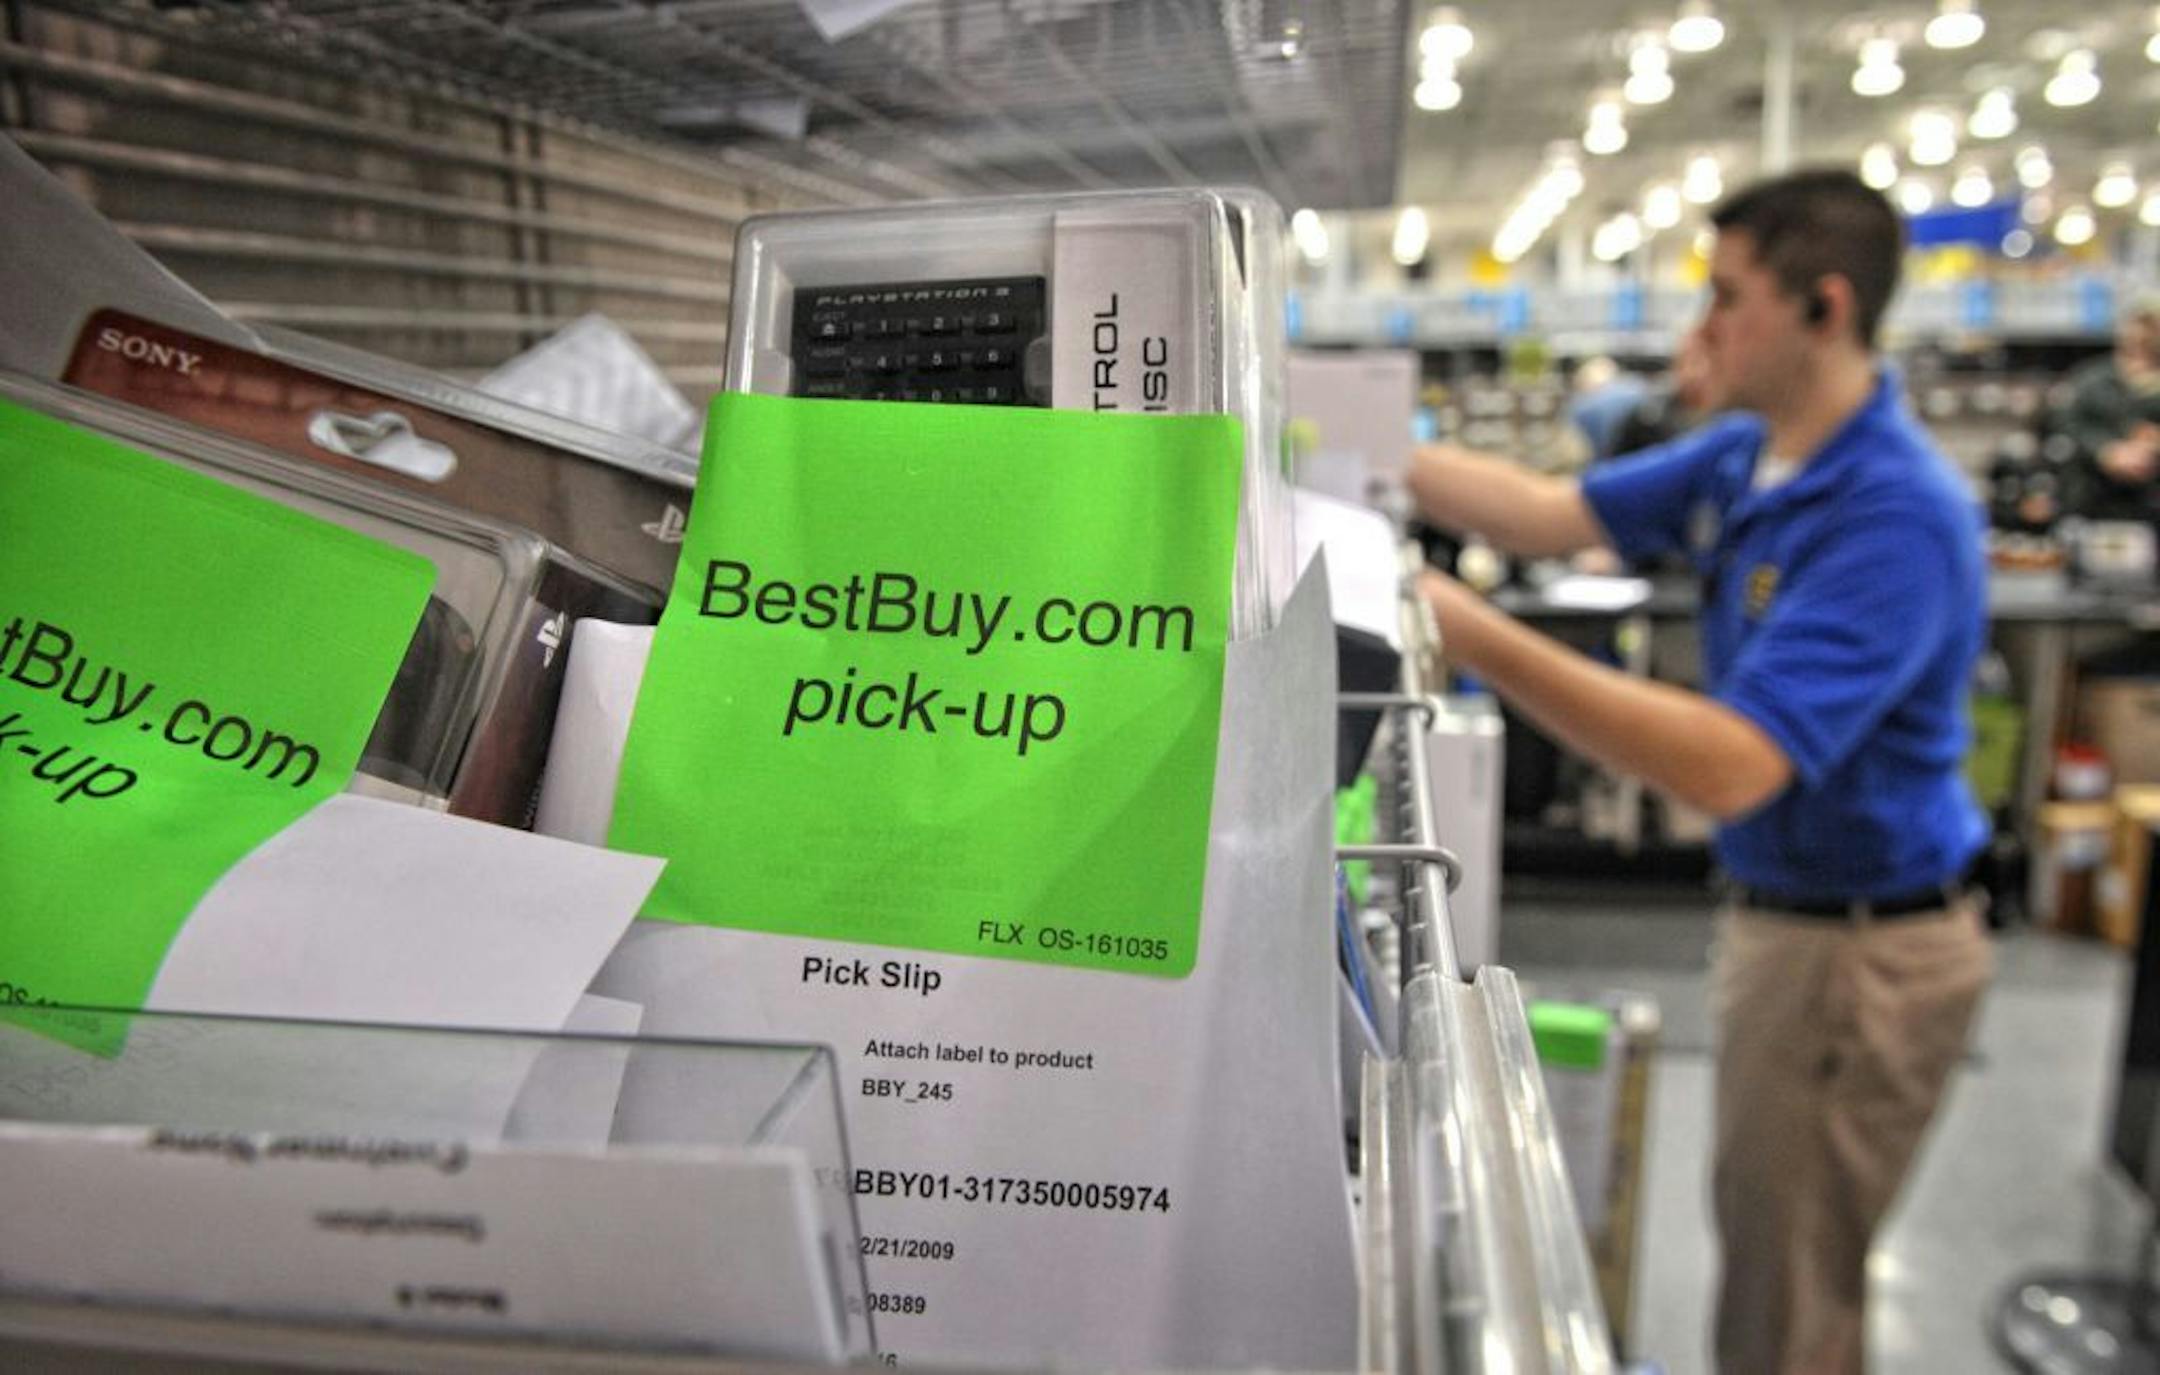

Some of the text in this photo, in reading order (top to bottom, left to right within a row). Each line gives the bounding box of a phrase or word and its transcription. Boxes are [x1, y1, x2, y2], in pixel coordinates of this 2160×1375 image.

[98, 327, 202, 375] SONY
[699, 559, 1194, 656] BestBuy.com
[0, 616, 320, 788] tBuy.com
[782, 667, 1066, 756] pick-up
[978, 920, 1169, 961] FLX OS-161035
[802, 956, 942, 996] Pick Slip
[864, 1039, 1095, 1073] Attach label to product
[861, 1078, 953, 1103] BBY_245
[854, 1168, 1171, 1213] BBY01-317350005974
